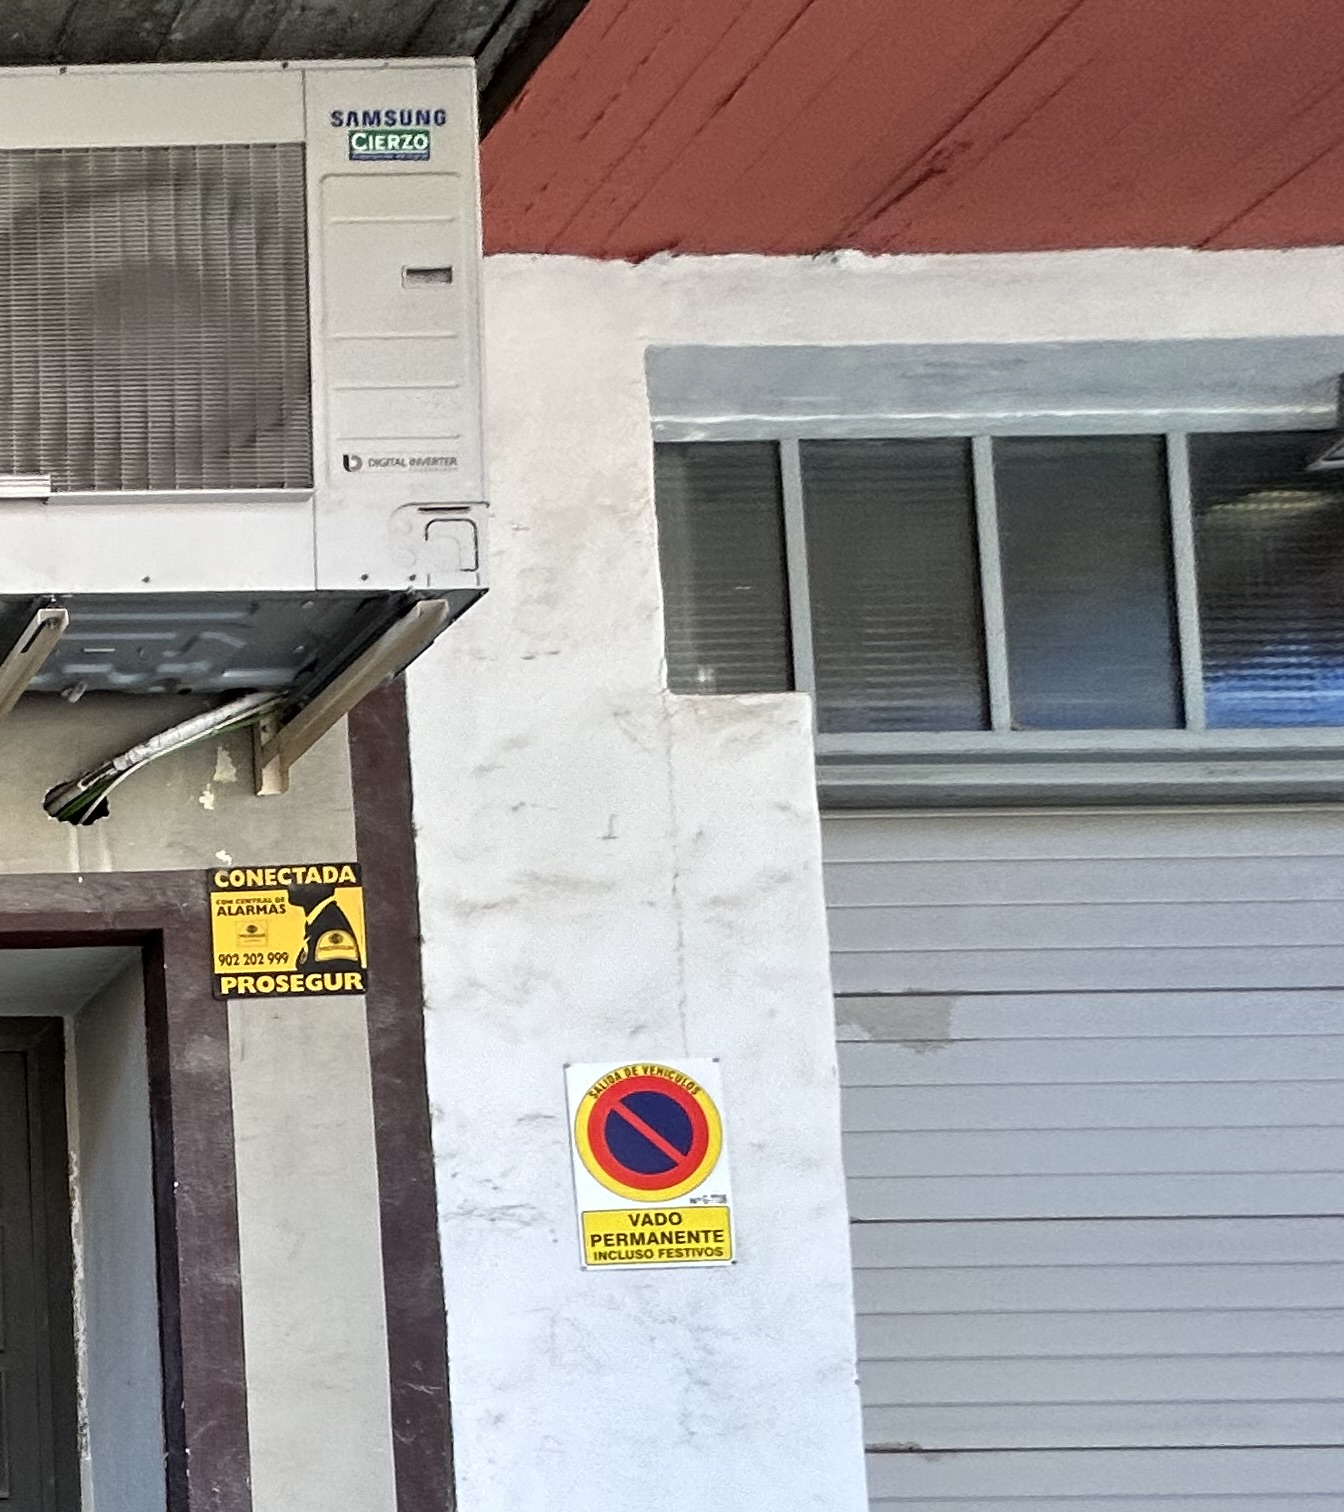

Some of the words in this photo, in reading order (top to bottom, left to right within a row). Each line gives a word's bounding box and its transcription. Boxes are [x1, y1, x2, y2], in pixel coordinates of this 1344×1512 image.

[330, 109, 447, 127] SAMSUNG
[351, 133, 429, 151] CIERZO
[368, 458, 407, 468] DIGITAL
[408, 457, 458, 467] INVERTER
[214, 865, 357, 888] CONECTADA
[216, 904, 287, 917] ALARMAS
[218, 952, 240, 967] 902
[243, 952, 264, 966] 202
[267, 951, 289, 965] 999
[220, 972, 364, 995] PROSEGUR
[588, 1071, 623, 1099] SALIDA
[623, 1066, 639, 1078] DE
[627, 1211, 683, 1227] VADO
[590, 1229, 725, 1248] PERMANENTE
[593, 1248, 654, 1261] INCLUSO
[658, 1246, 724, 1259] FESTIVOS
